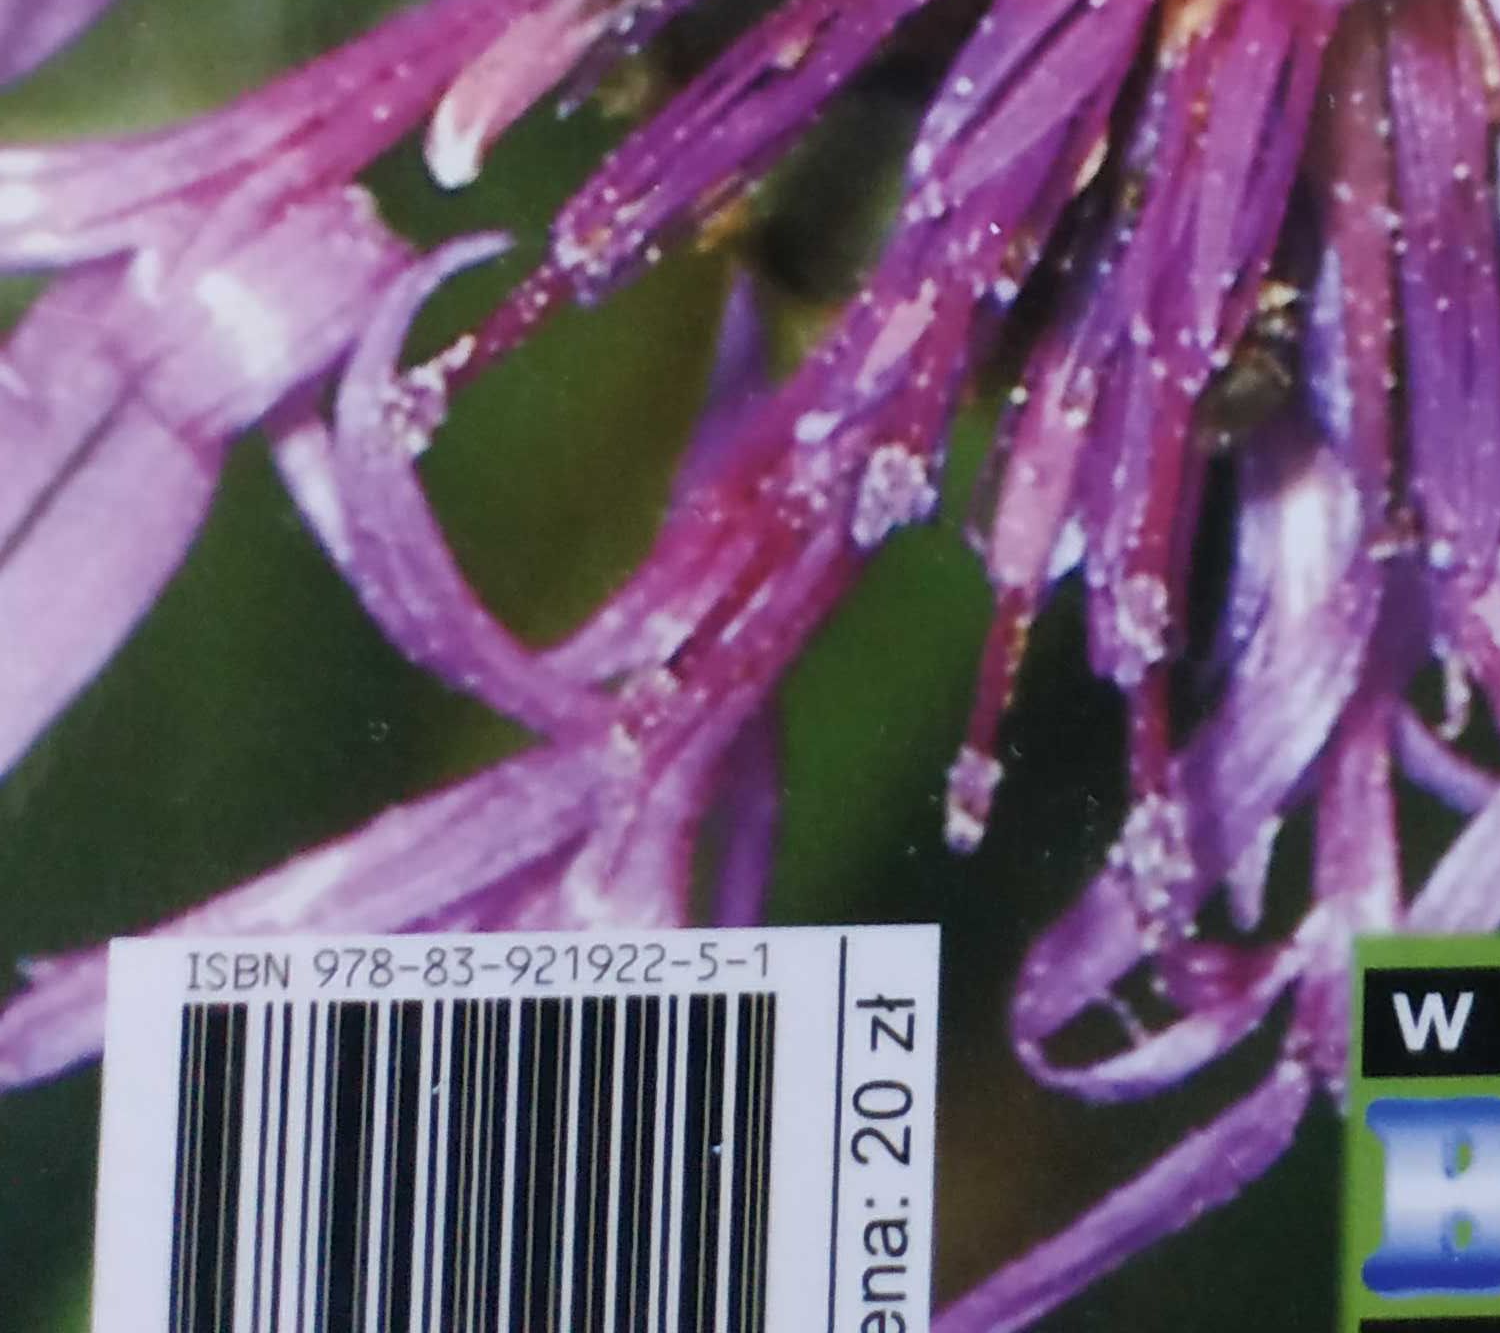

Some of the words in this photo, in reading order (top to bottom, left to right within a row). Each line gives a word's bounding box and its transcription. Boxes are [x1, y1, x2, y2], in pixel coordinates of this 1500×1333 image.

[186, 951, 292, 991] ISBN
[314, 944, 770, 987] 978-83-921922-5-1
[855, 994, 916, 1053] zł
[851, 1079, 914, 1166] 20
